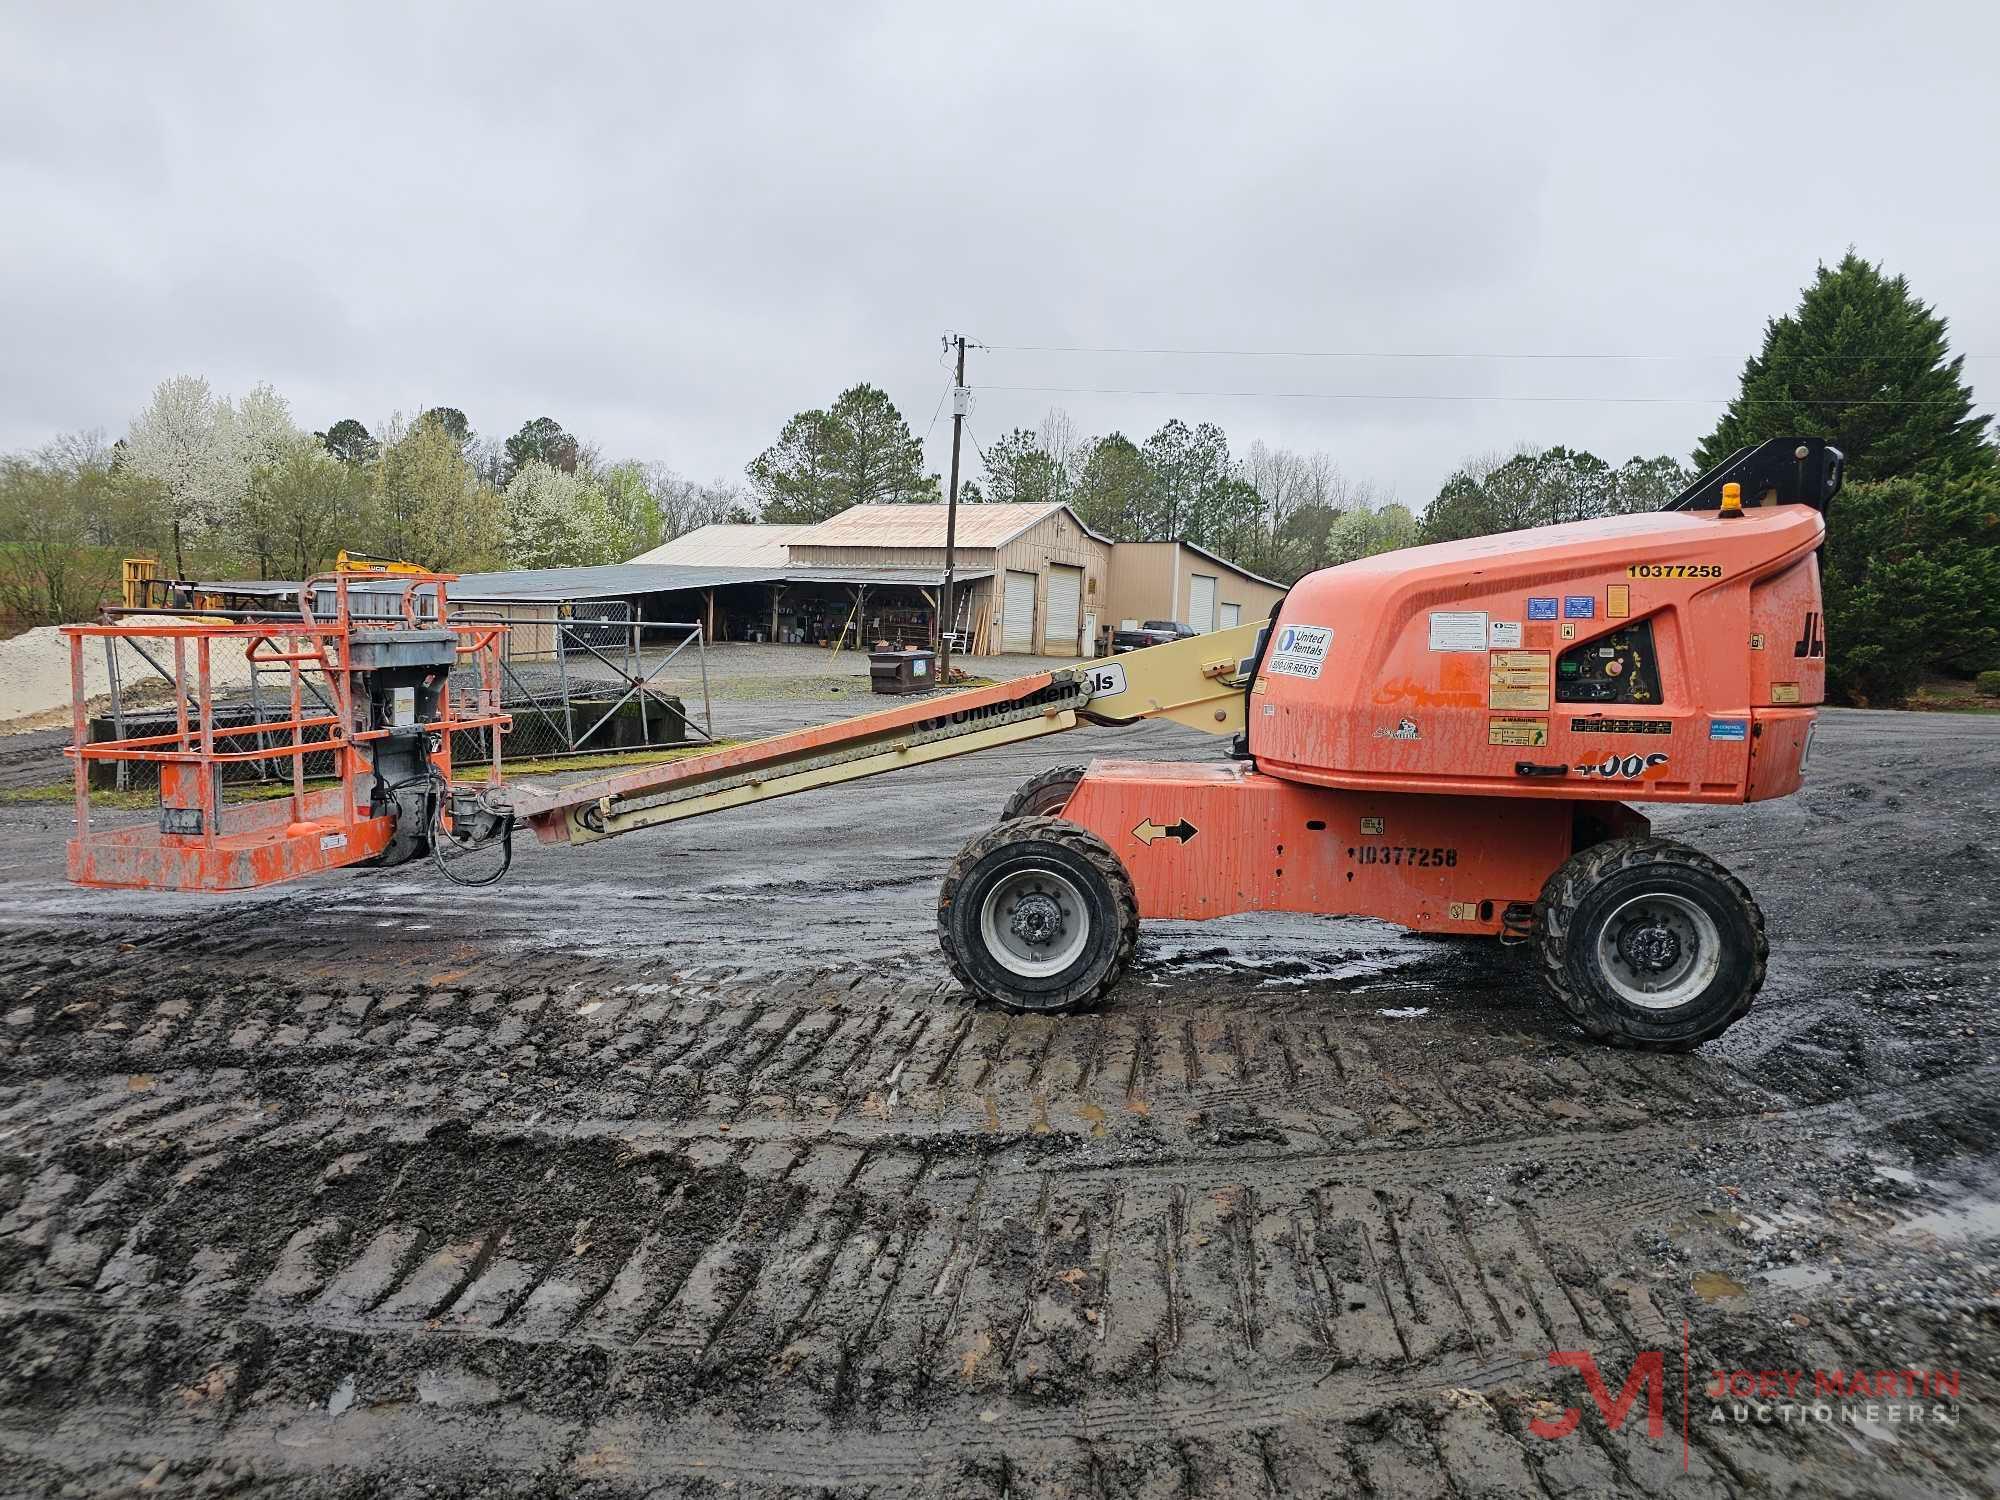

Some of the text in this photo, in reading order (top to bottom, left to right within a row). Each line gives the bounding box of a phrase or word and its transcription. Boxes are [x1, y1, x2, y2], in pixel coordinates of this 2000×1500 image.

[1629, 565, 1722, 578] 10377258
[1296, 631, 1325, 644] United
[1292, 642, 1323, 656] Rentals
[1358, 846, 1458, 867] 10377258
